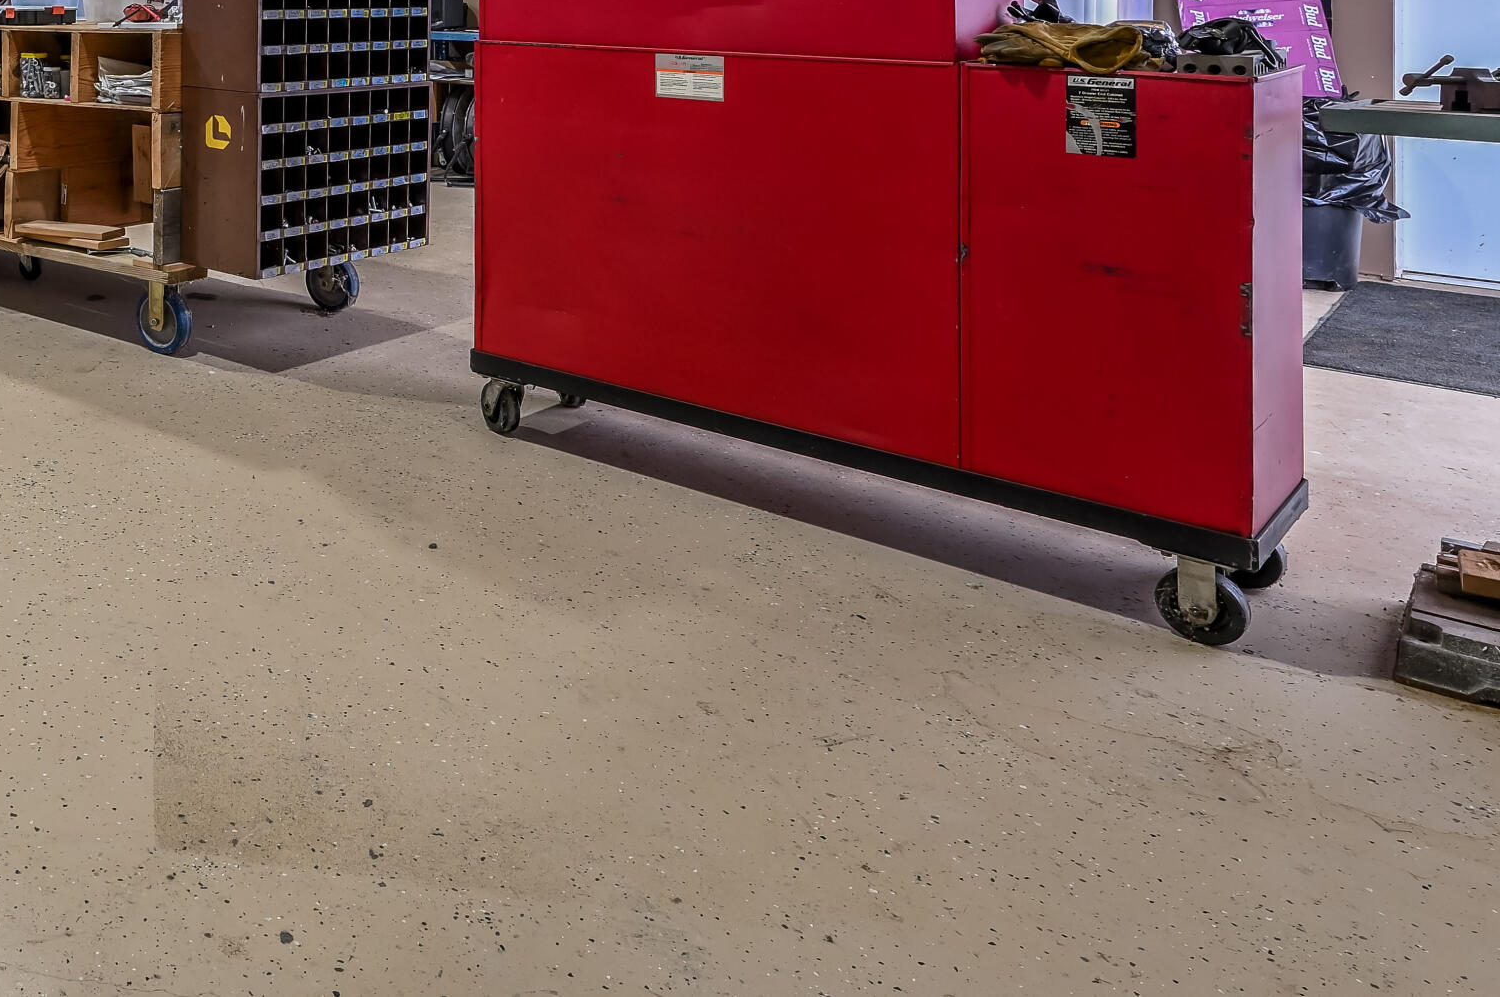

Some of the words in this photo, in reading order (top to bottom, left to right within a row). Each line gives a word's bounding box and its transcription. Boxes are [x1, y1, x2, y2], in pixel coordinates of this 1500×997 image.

[1189, 9, 1205, 26] ud
[1303, 3, 1324, 28] Bud
[1310, 34, 1332, 60] Bud
[1086, 78, 1132, 88] General
[1318, 67, 1339, 93] Bud
